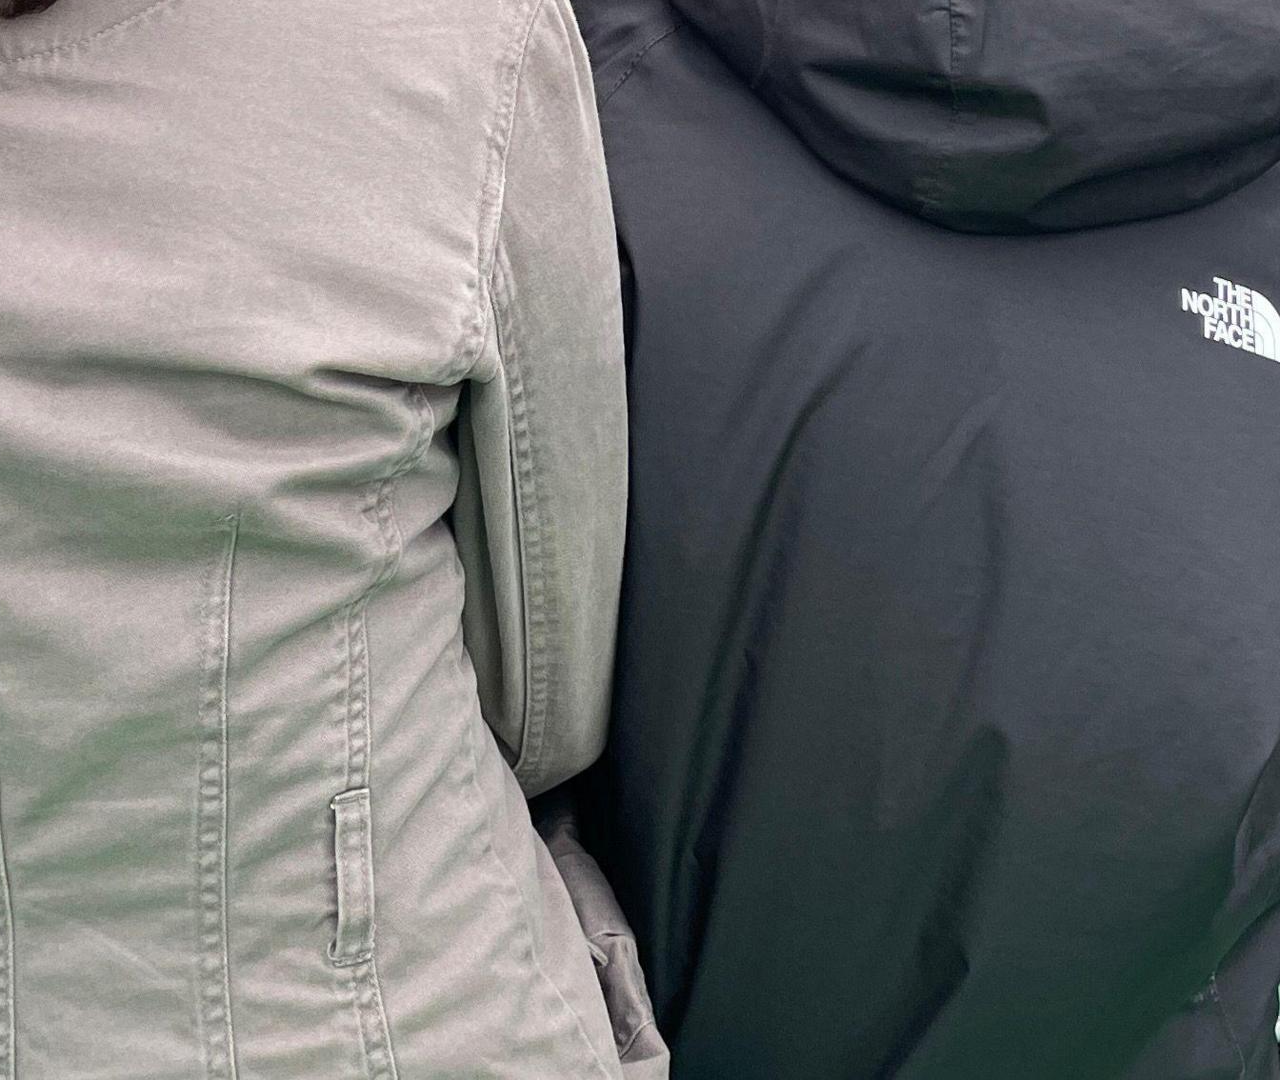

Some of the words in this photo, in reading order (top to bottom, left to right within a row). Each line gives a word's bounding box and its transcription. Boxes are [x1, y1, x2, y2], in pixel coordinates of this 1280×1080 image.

[1181, 288, 1254, 330] NORTH
[1212, 276, 1253, 307] THE
[1203, 316, 1255, 353] FACE
